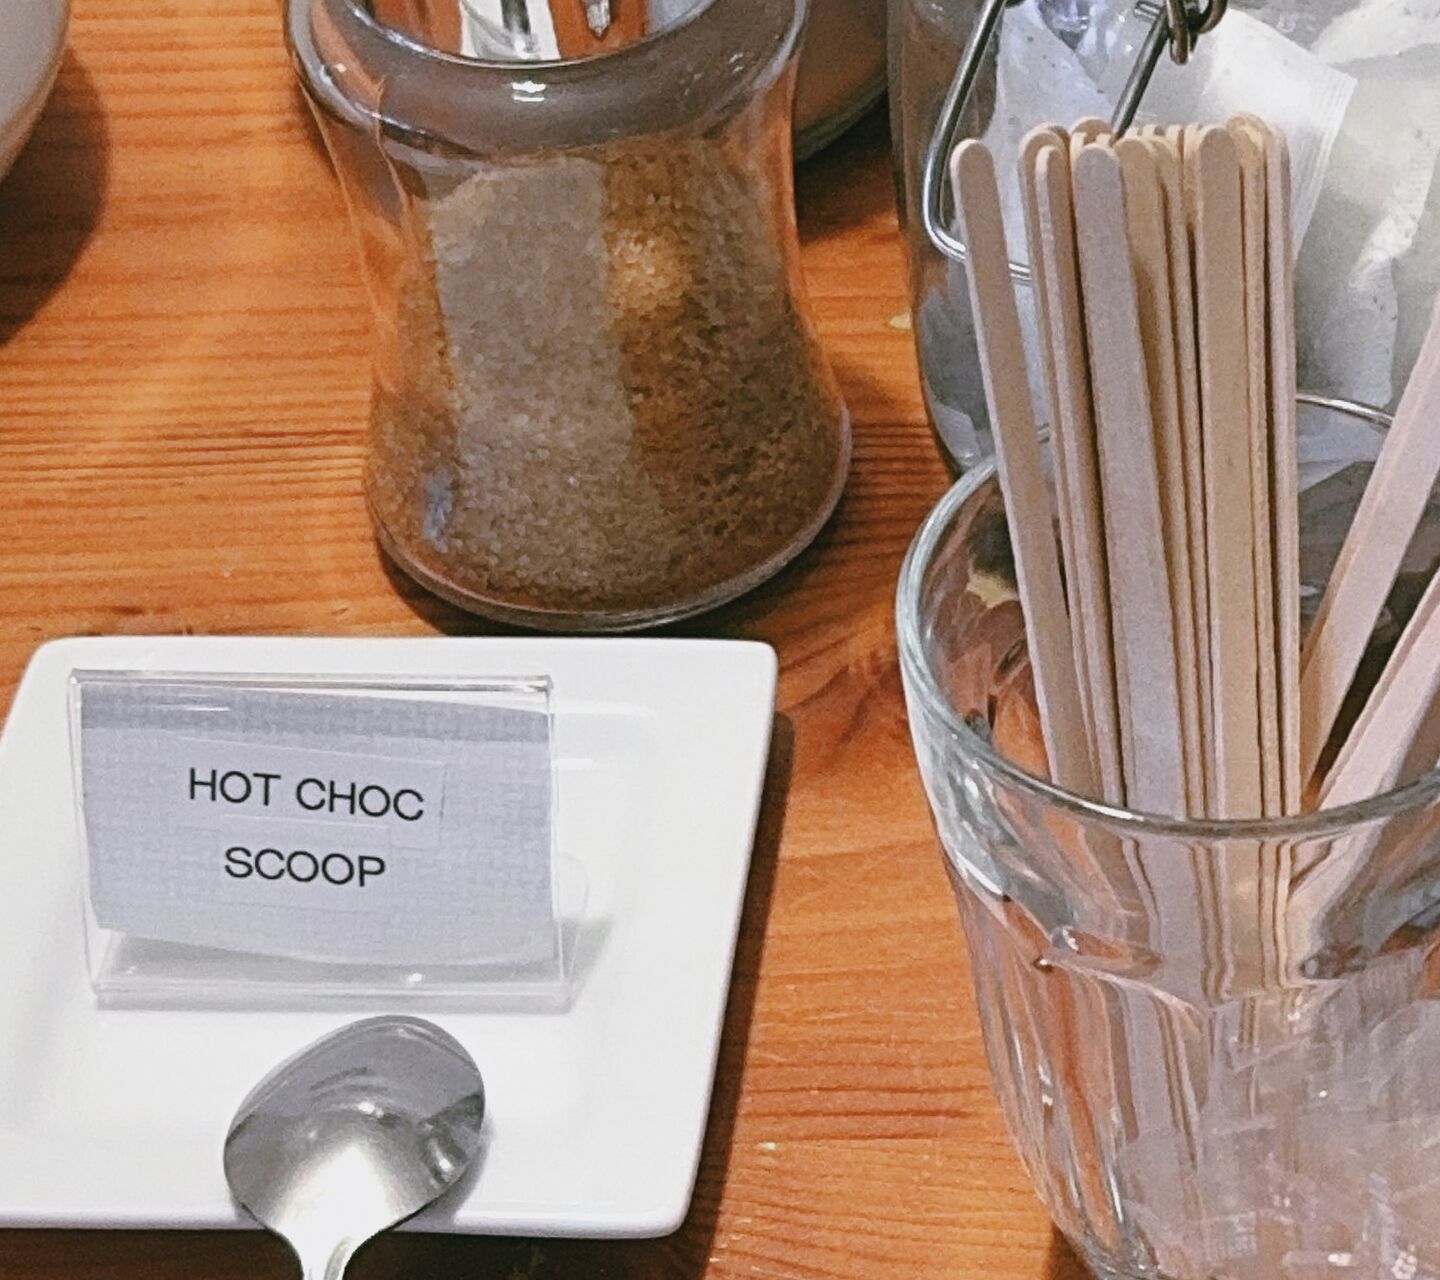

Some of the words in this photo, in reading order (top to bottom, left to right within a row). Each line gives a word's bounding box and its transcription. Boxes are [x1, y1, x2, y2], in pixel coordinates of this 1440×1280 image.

[187, 766, 282, 807] HOT
[295, 777, 425, 822] CHOC
[224, 846, 386, 887] SCOOP
